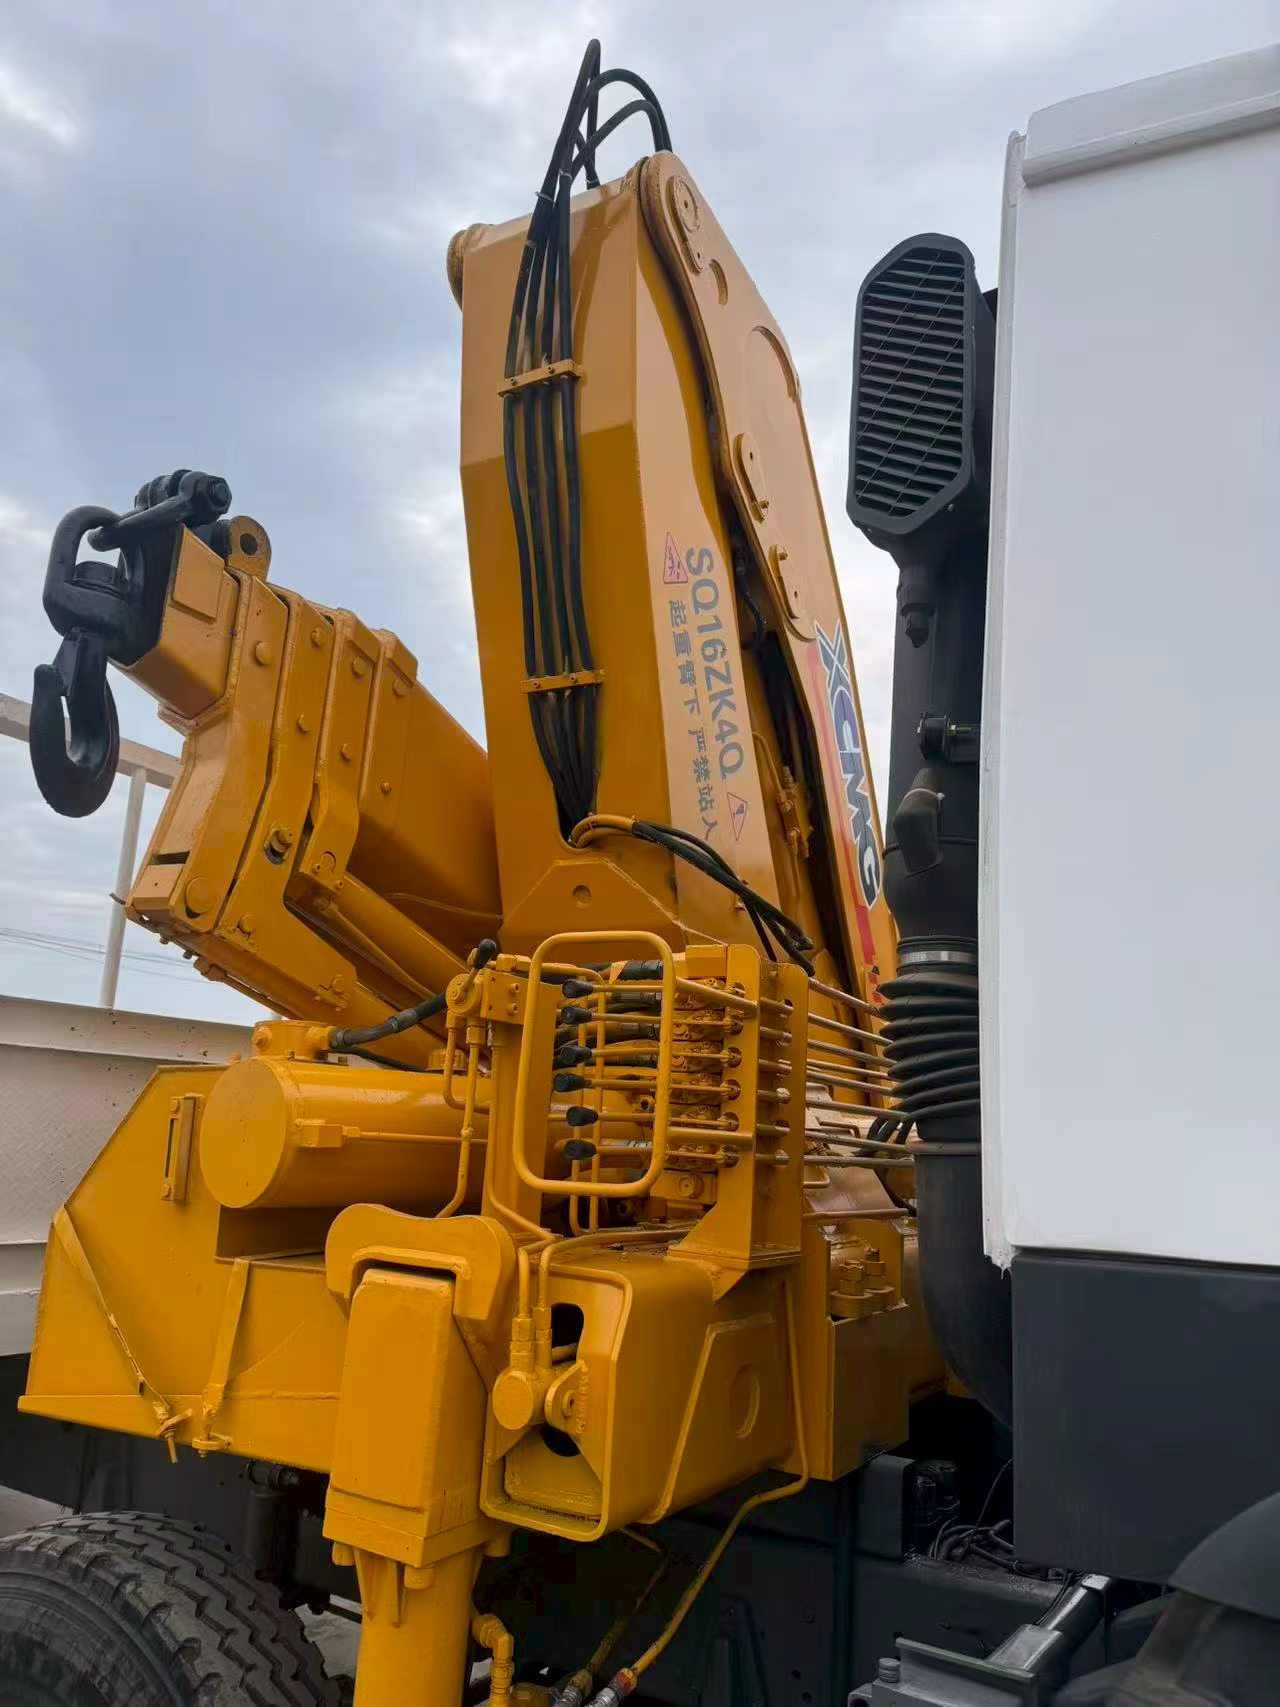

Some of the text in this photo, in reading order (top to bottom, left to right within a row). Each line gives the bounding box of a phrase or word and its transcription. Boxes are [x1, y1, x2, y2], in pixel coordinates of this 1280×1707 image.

[669, 600, 718, 840] 起重臂下 严禁站人
[686, 548, 745, 780] SQ16ZK4Q
[814, 619, 883, 910] XCMG
